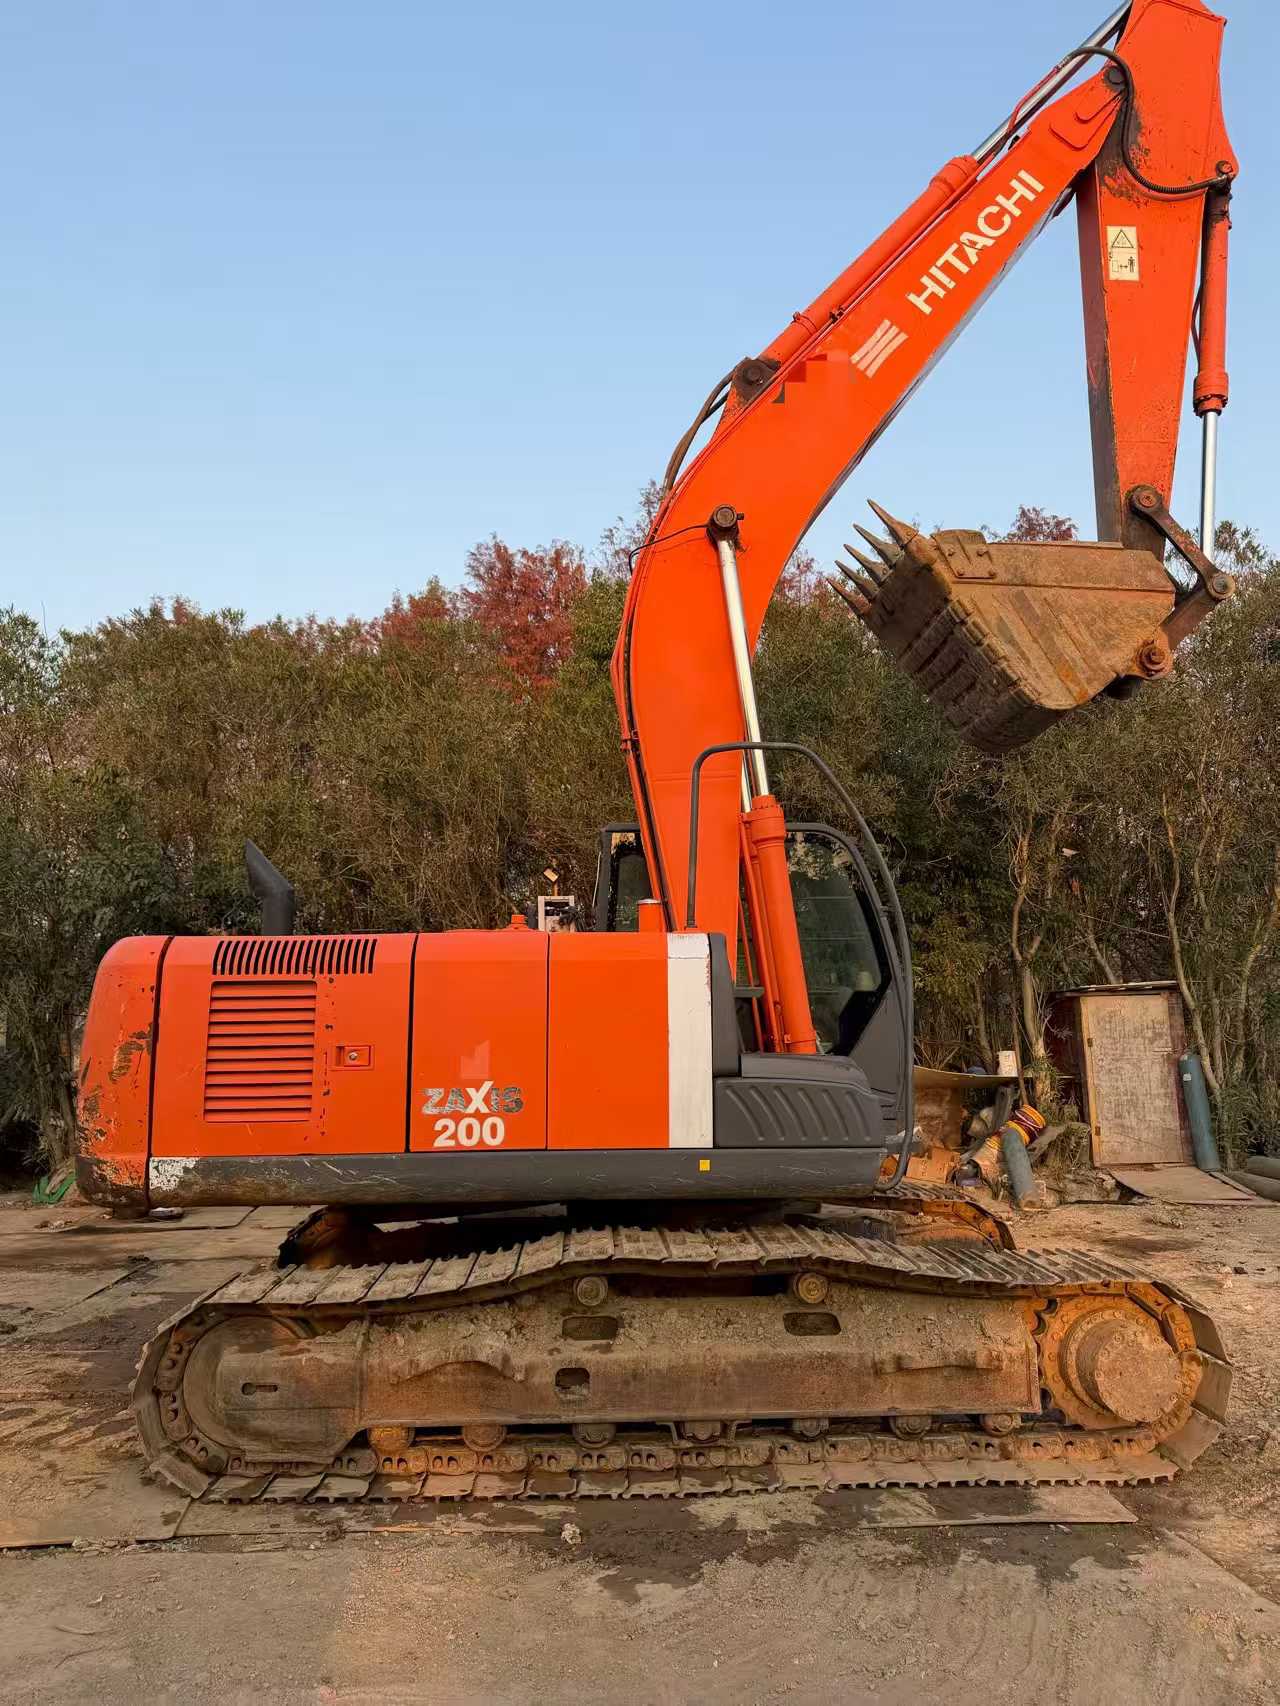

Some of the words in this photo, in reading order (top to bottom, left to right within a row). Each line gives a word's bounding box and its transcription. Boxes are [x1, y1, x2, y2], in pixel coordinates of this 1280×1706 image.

[907, 169, 1045, 315] HITACHI
[421, 1081, 524, 1114] ZAXIS
[433, 1117, 505, 1147] 200
